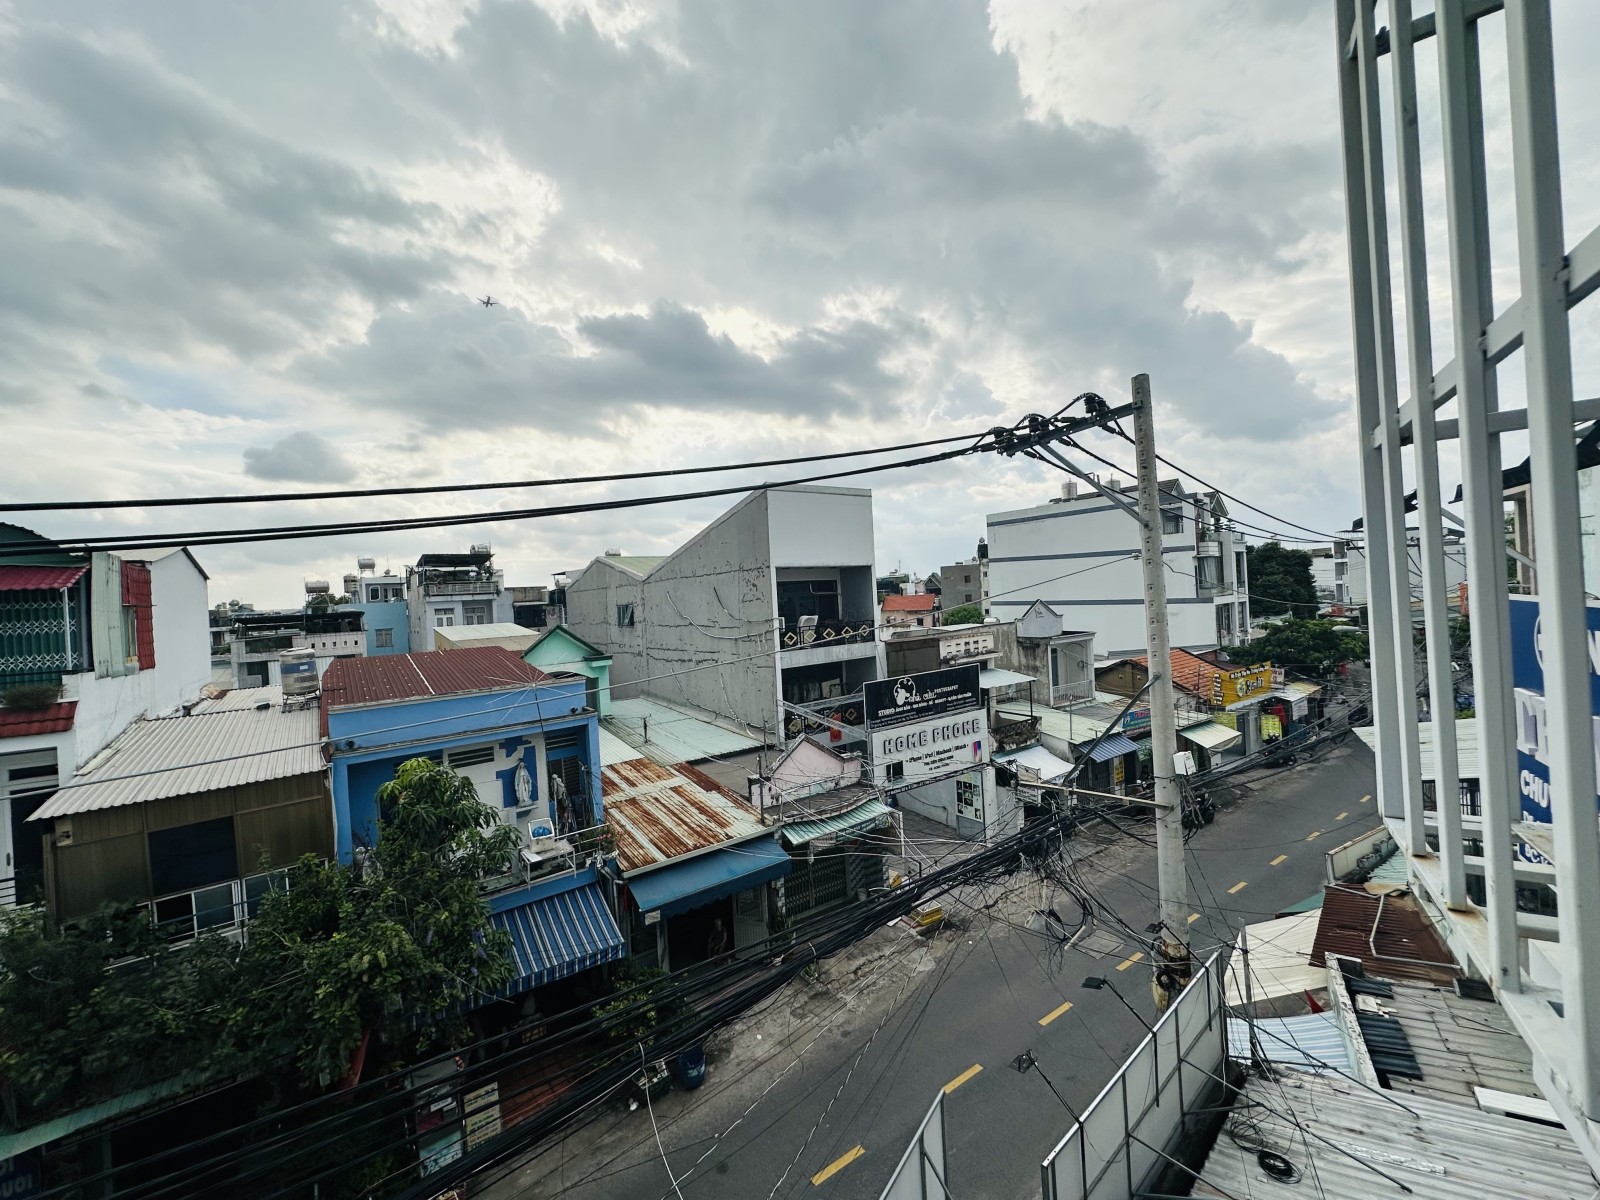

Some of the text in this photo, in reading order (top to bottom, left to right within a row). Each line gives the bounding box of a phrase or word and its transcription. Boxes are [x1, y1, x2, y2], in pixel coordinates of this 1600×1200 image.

[884, 732, 928, 755] HOME
[933, 719, 981, 743] PHONE
[1520, 770, 1551, 808] CHU
